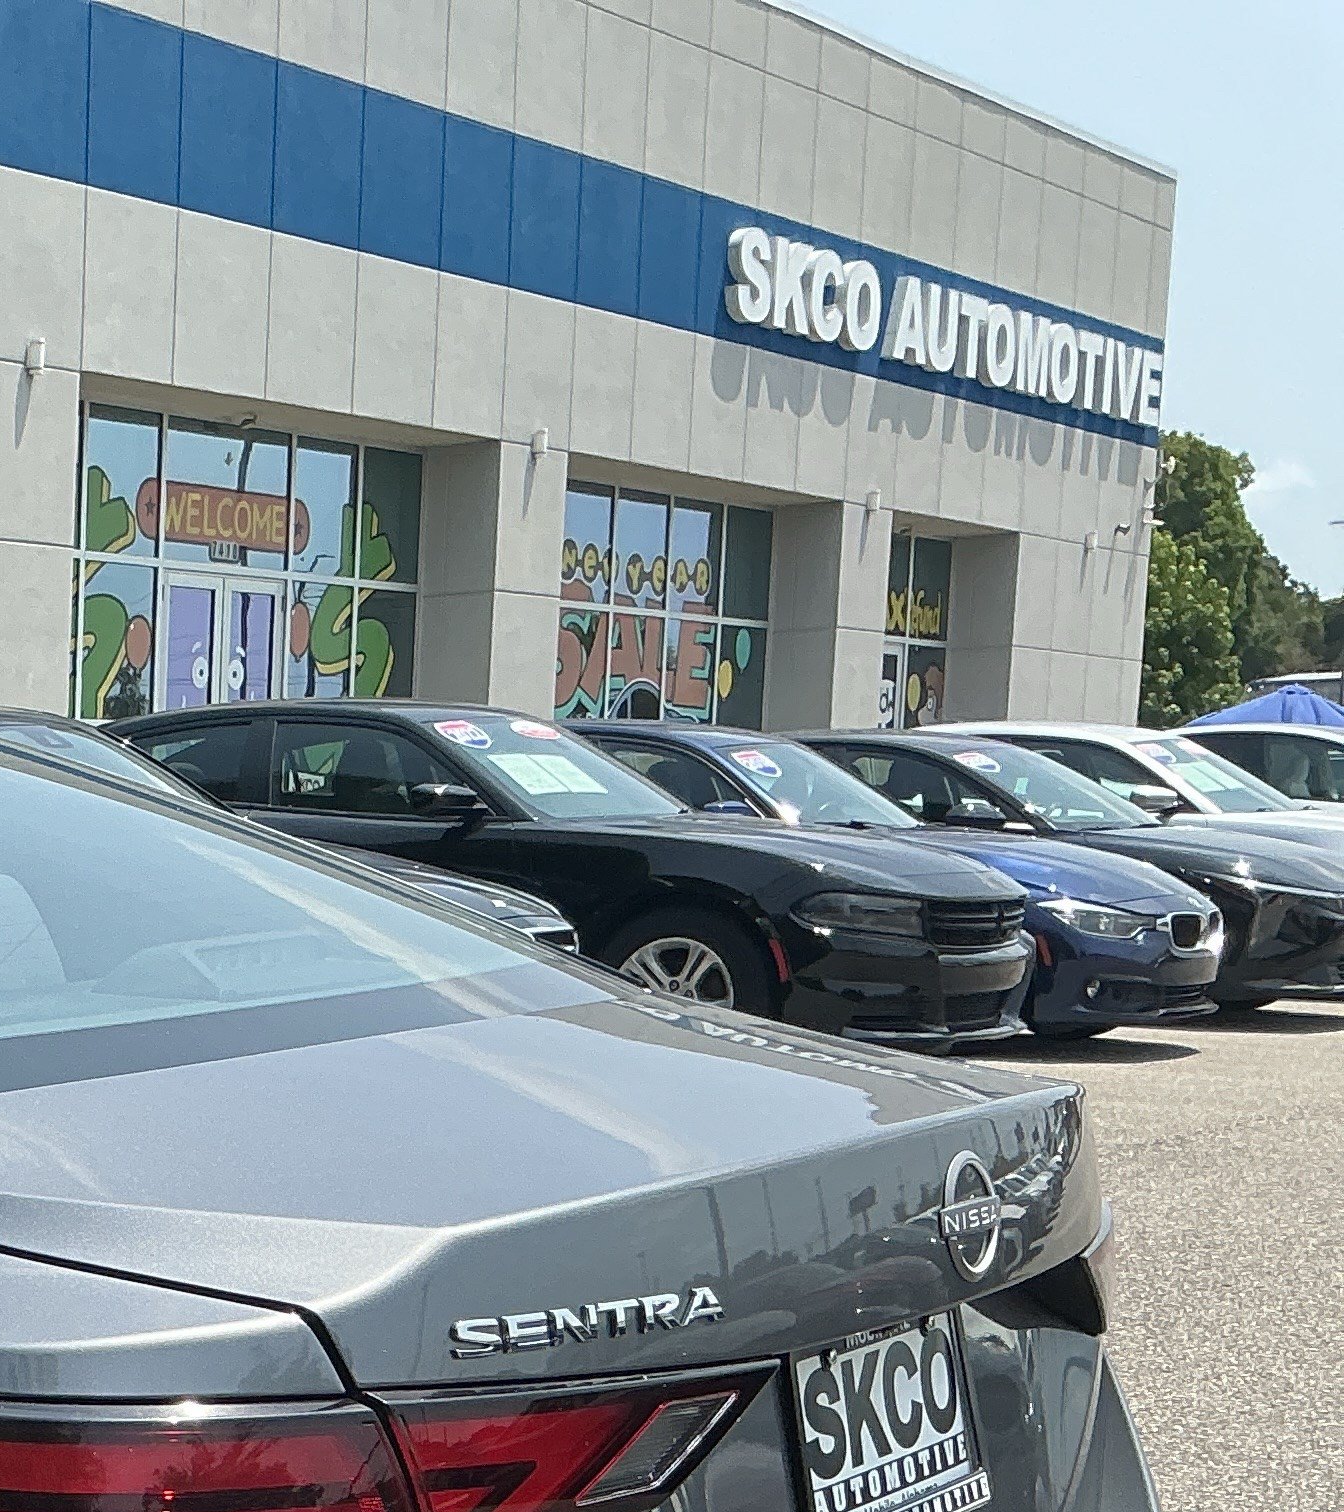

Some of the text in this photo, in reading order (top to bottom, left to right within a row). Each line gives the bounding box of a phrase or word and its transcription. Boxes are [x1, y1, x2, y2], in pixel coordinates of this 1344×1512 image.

[725, 226, 1163, 426] SKCO AUTOMOTIVE
[165, 491, 287, 544] WELCOME
[944, 1204, 997, 1234] NISSA
[449, 1286, 726, 1358] SENTRA
[804, 1327, 958, 1480] SKCO
